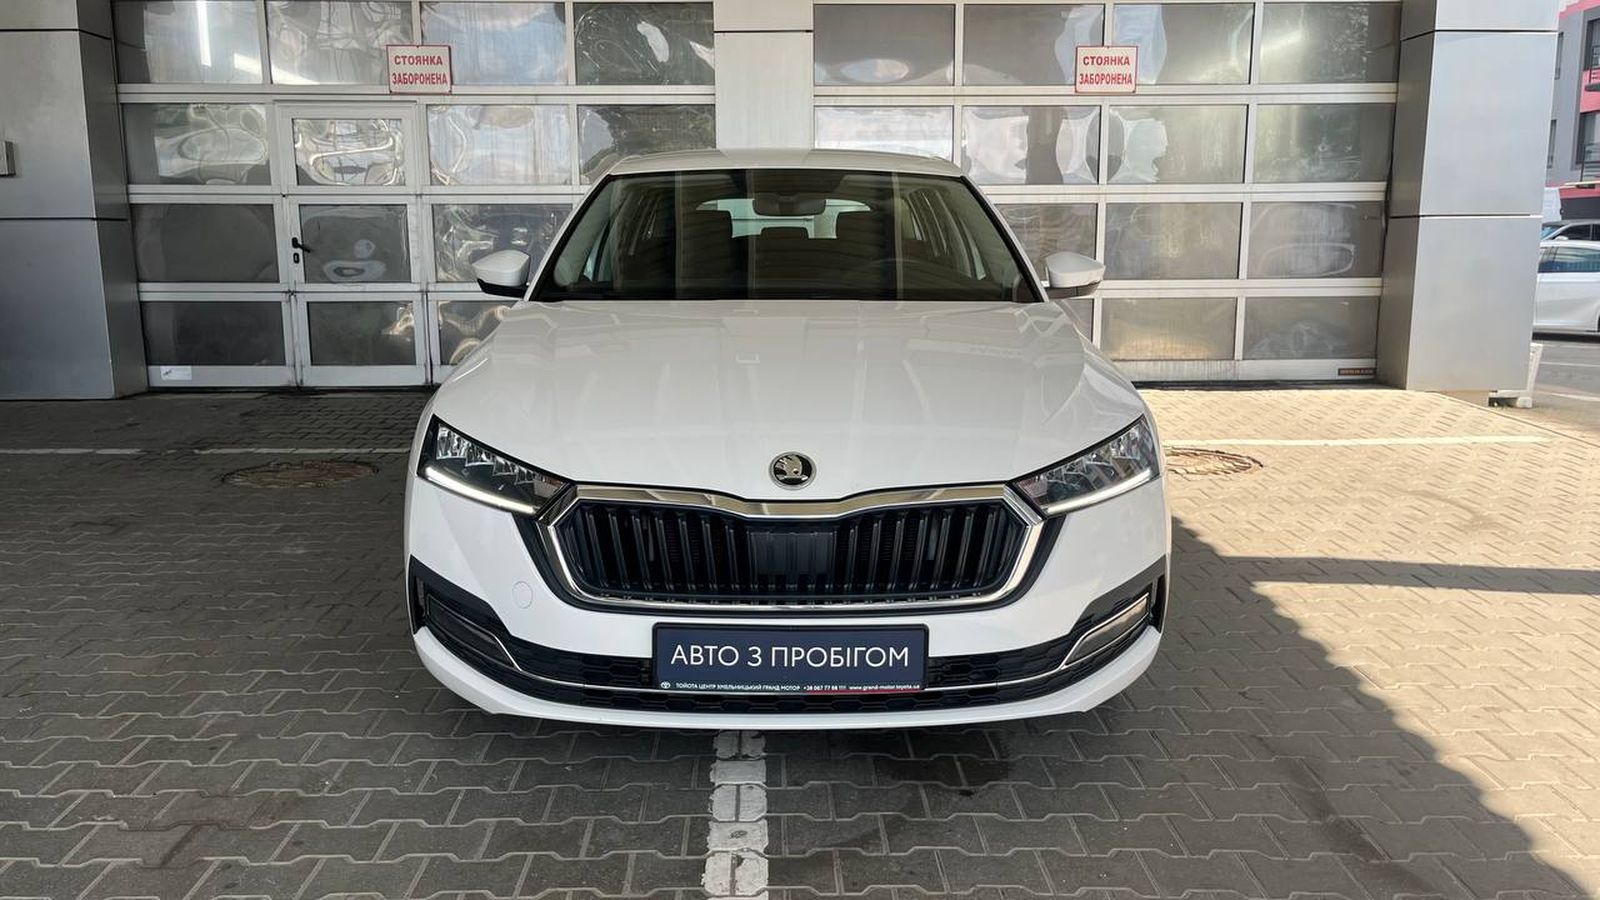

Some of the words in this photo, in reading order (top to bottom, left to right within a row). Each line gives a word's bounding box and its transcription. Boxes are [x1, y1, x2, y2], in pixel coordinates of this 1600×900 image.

[394, 55, 443, 65] СТОЯНКА
[1083, 56, 1130, 65] СТОЯНКА
[392, 73, 448, 84] ЗАБОРОНЕНА
[1080, 73, 1132, 84] ЗАБОРОНЕНА
[671, 645, 739, 666] АВТО
[771, 647, 909, 667] ПРОБІГОМ
